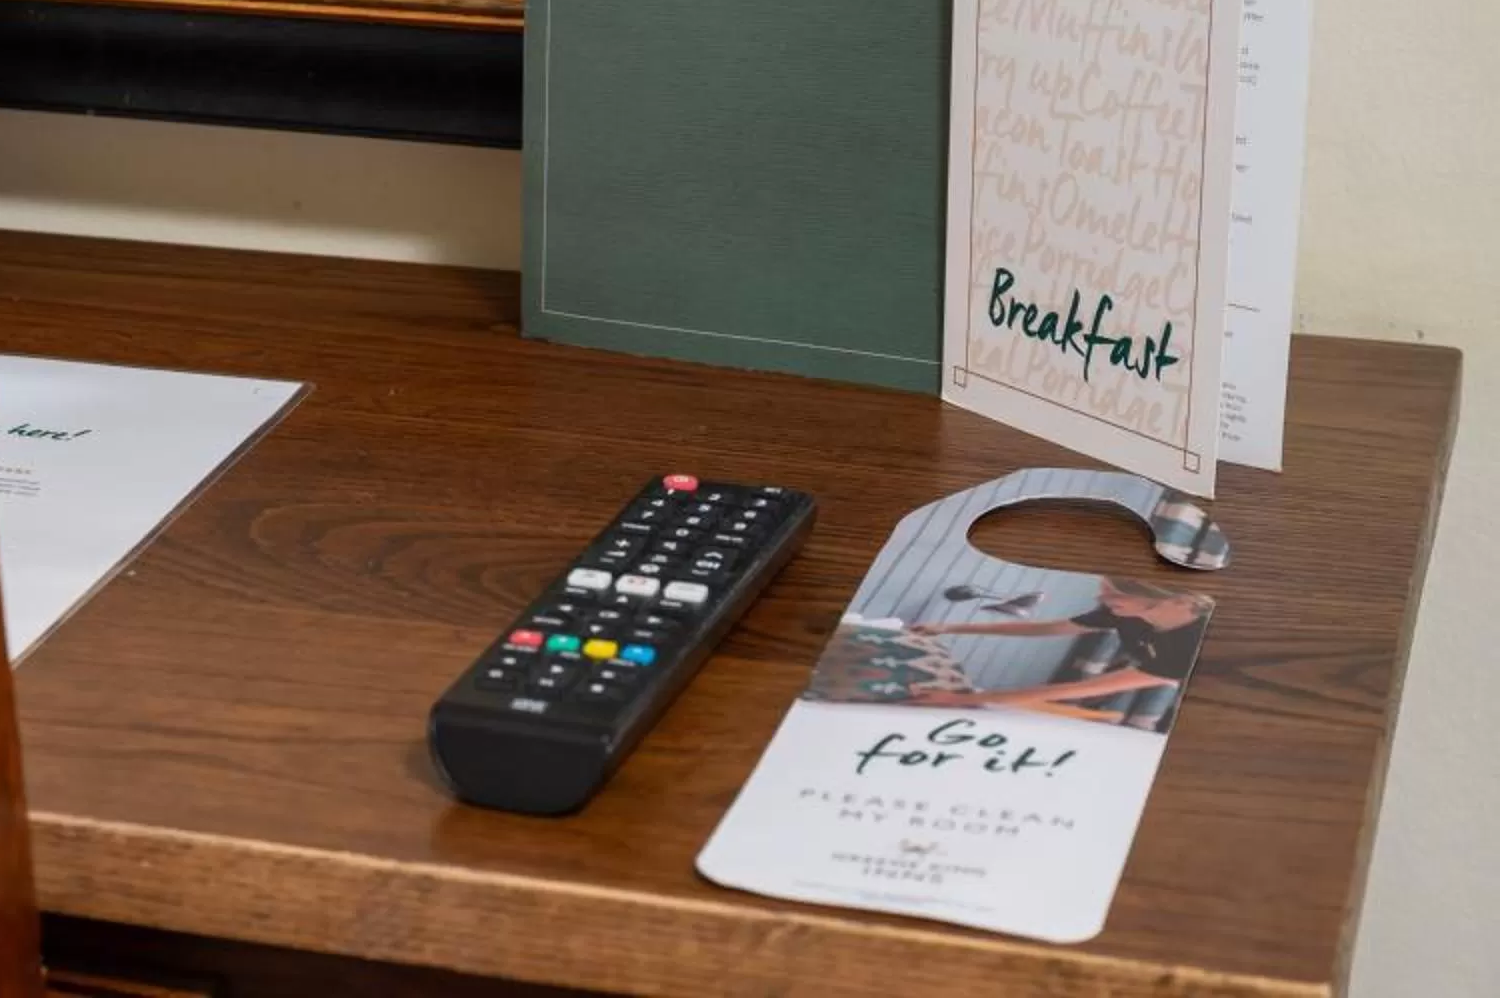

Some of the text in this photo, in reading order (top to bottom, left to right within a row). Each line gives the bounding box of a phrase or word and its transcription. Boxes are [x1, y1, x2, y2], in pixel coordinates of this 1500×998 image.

[989, 267, 1180, 383] Breakfast
[7, 422, 93, 441] here!
[927, 718, 1008, 748] Go
[856, 733, 1077, 777] for it!
[799, 786, 1076, 830] PLEASE CLEAN
[838, 807, 1021, 836] MY ROOM
